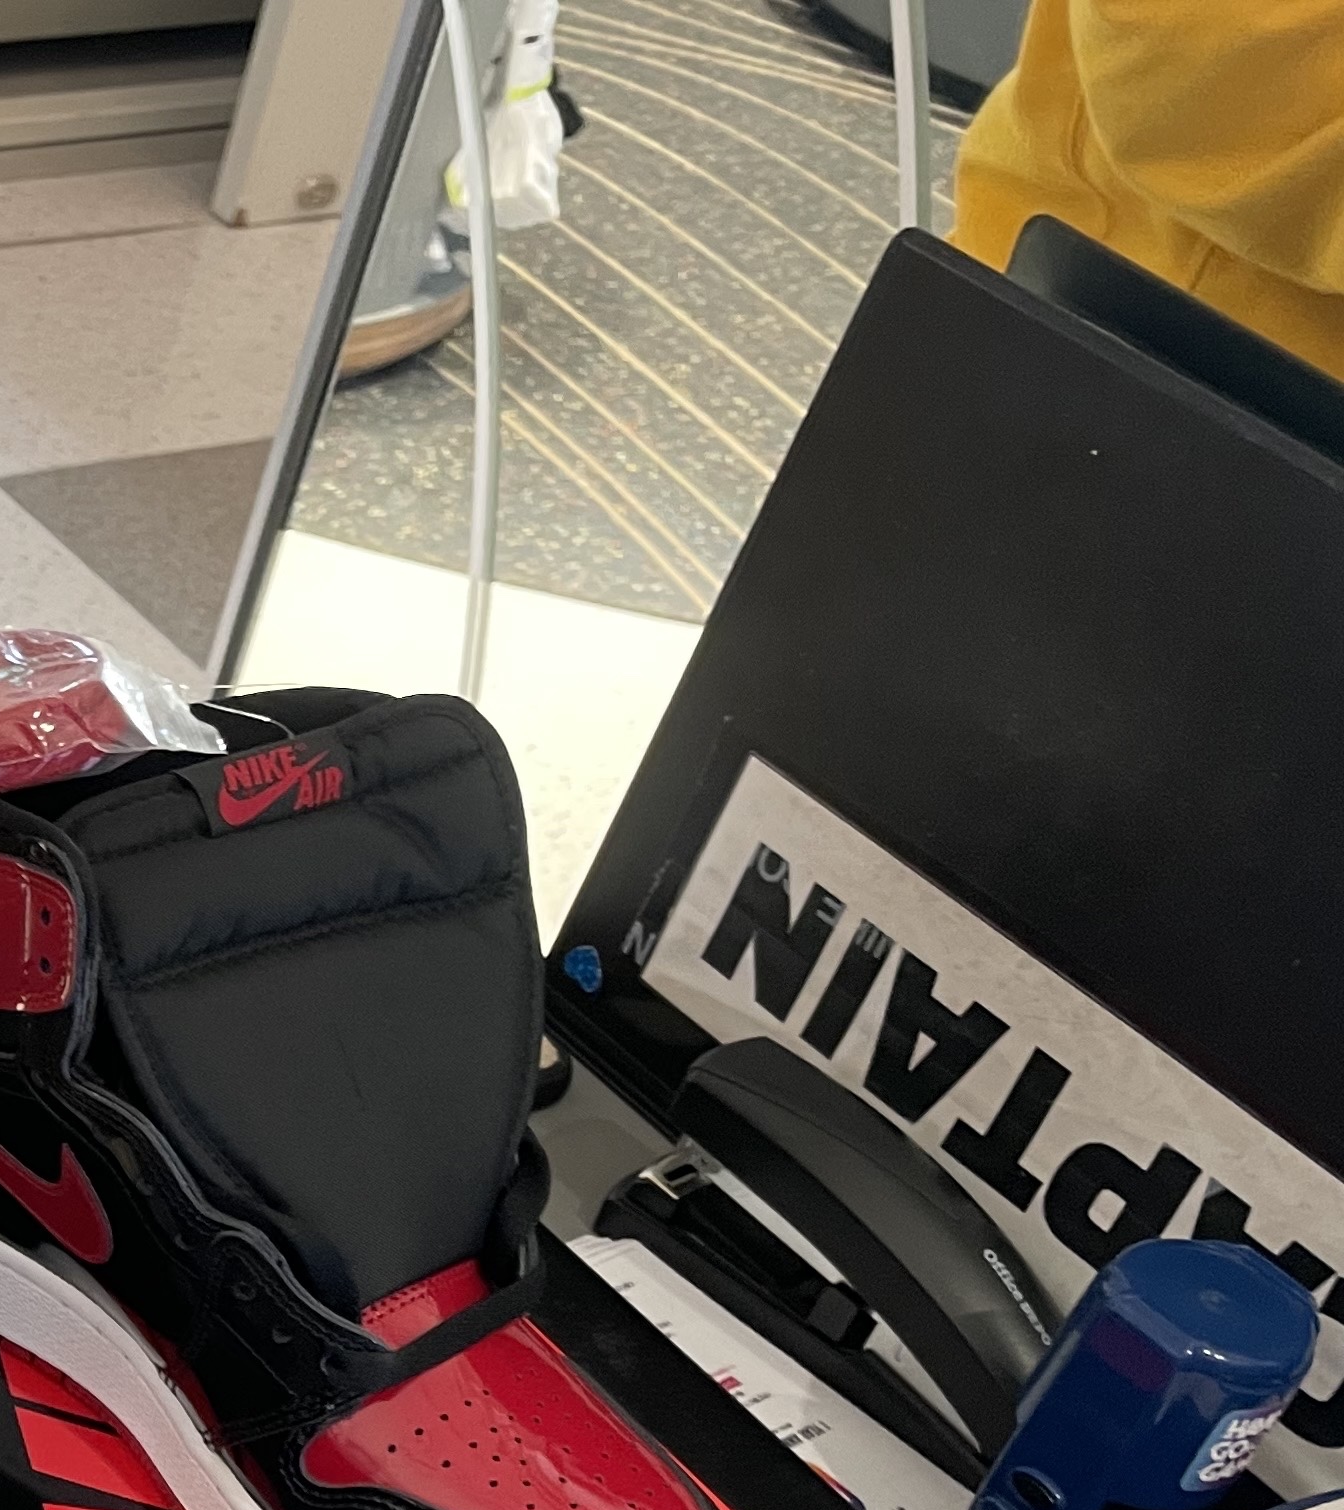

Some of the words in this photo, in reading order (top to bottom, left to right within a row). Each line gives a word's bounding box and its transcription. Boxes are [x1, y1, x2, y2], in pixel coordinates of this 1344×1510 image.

[223, 746, 299, 792] NIKE
[293, 766, 345, 812] AIR
[701, 842, 1344, 1447] PTAIN
